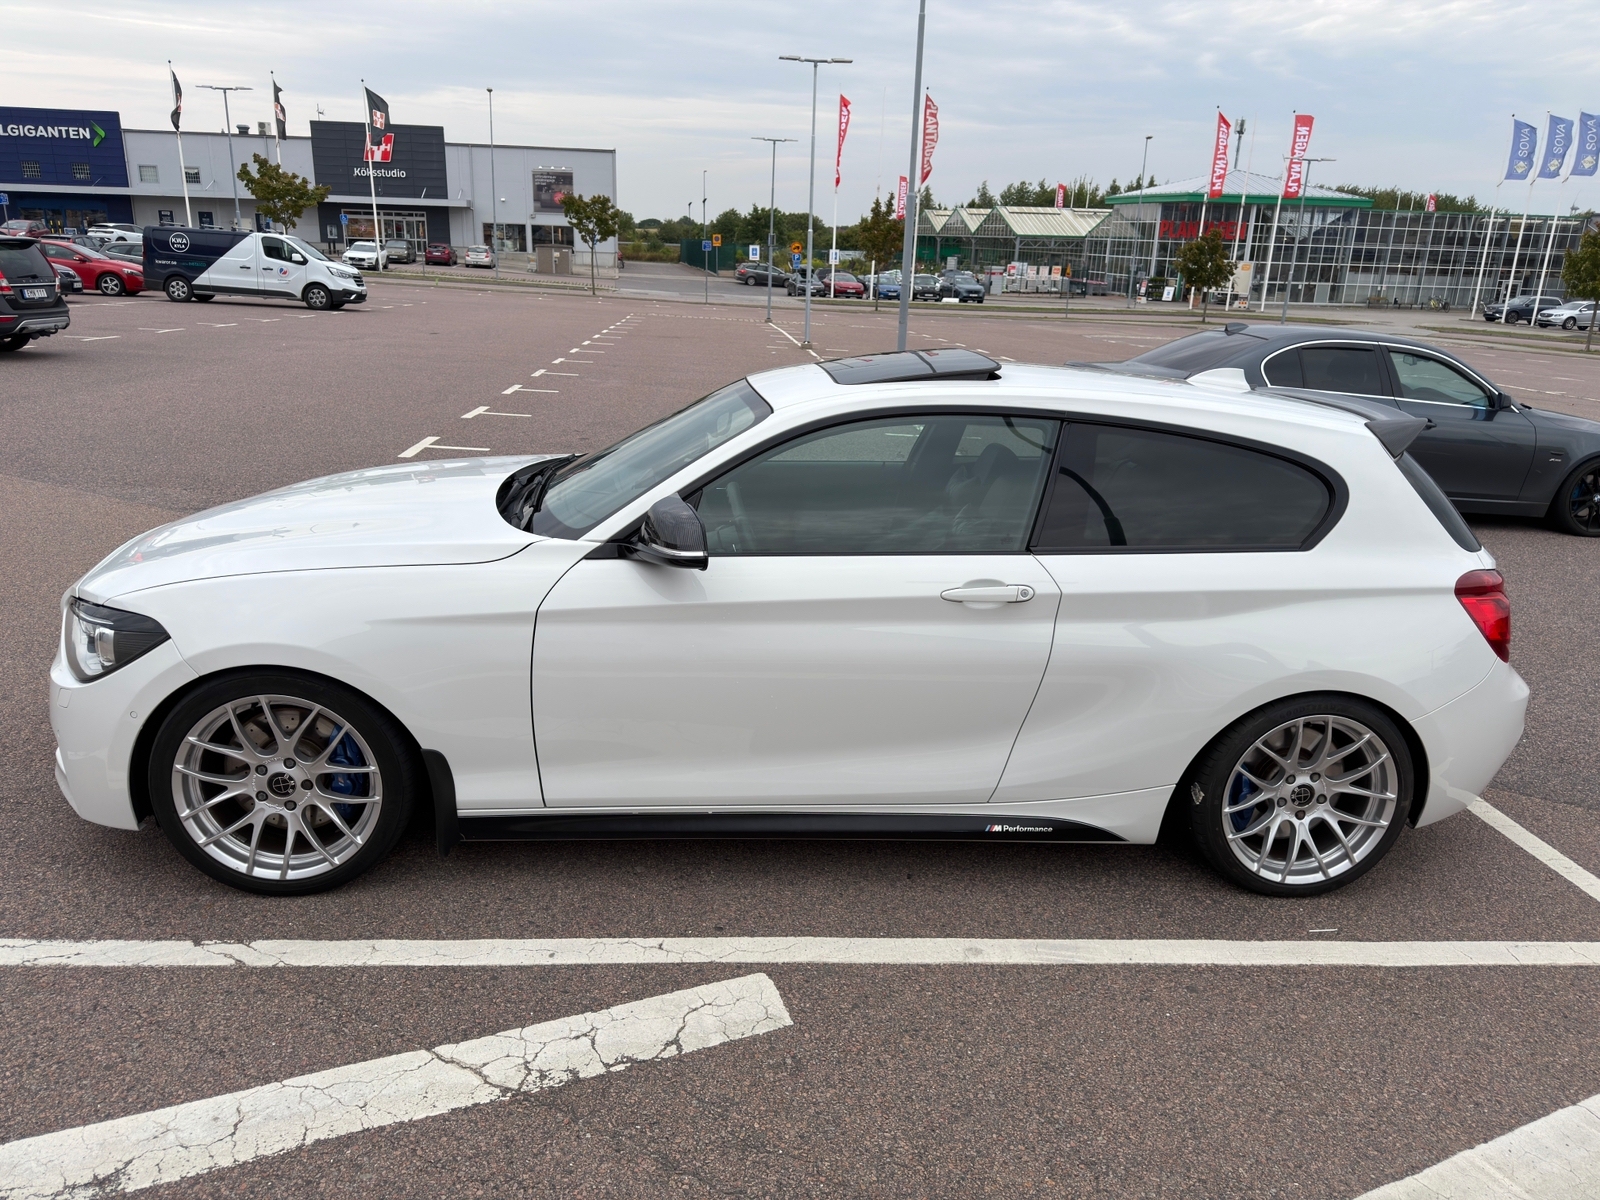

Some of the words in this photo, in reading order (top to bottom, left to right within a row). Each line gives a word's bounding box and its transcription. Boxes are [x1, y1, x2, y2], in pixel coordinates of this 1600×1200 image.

[1518, 128, 1530, 157] SOVA
[1553, 123, 1566, 154] SOVA
[1586, 119, 1597, 151] SOVA
[354, 167, 406, 178] Köksstudio
